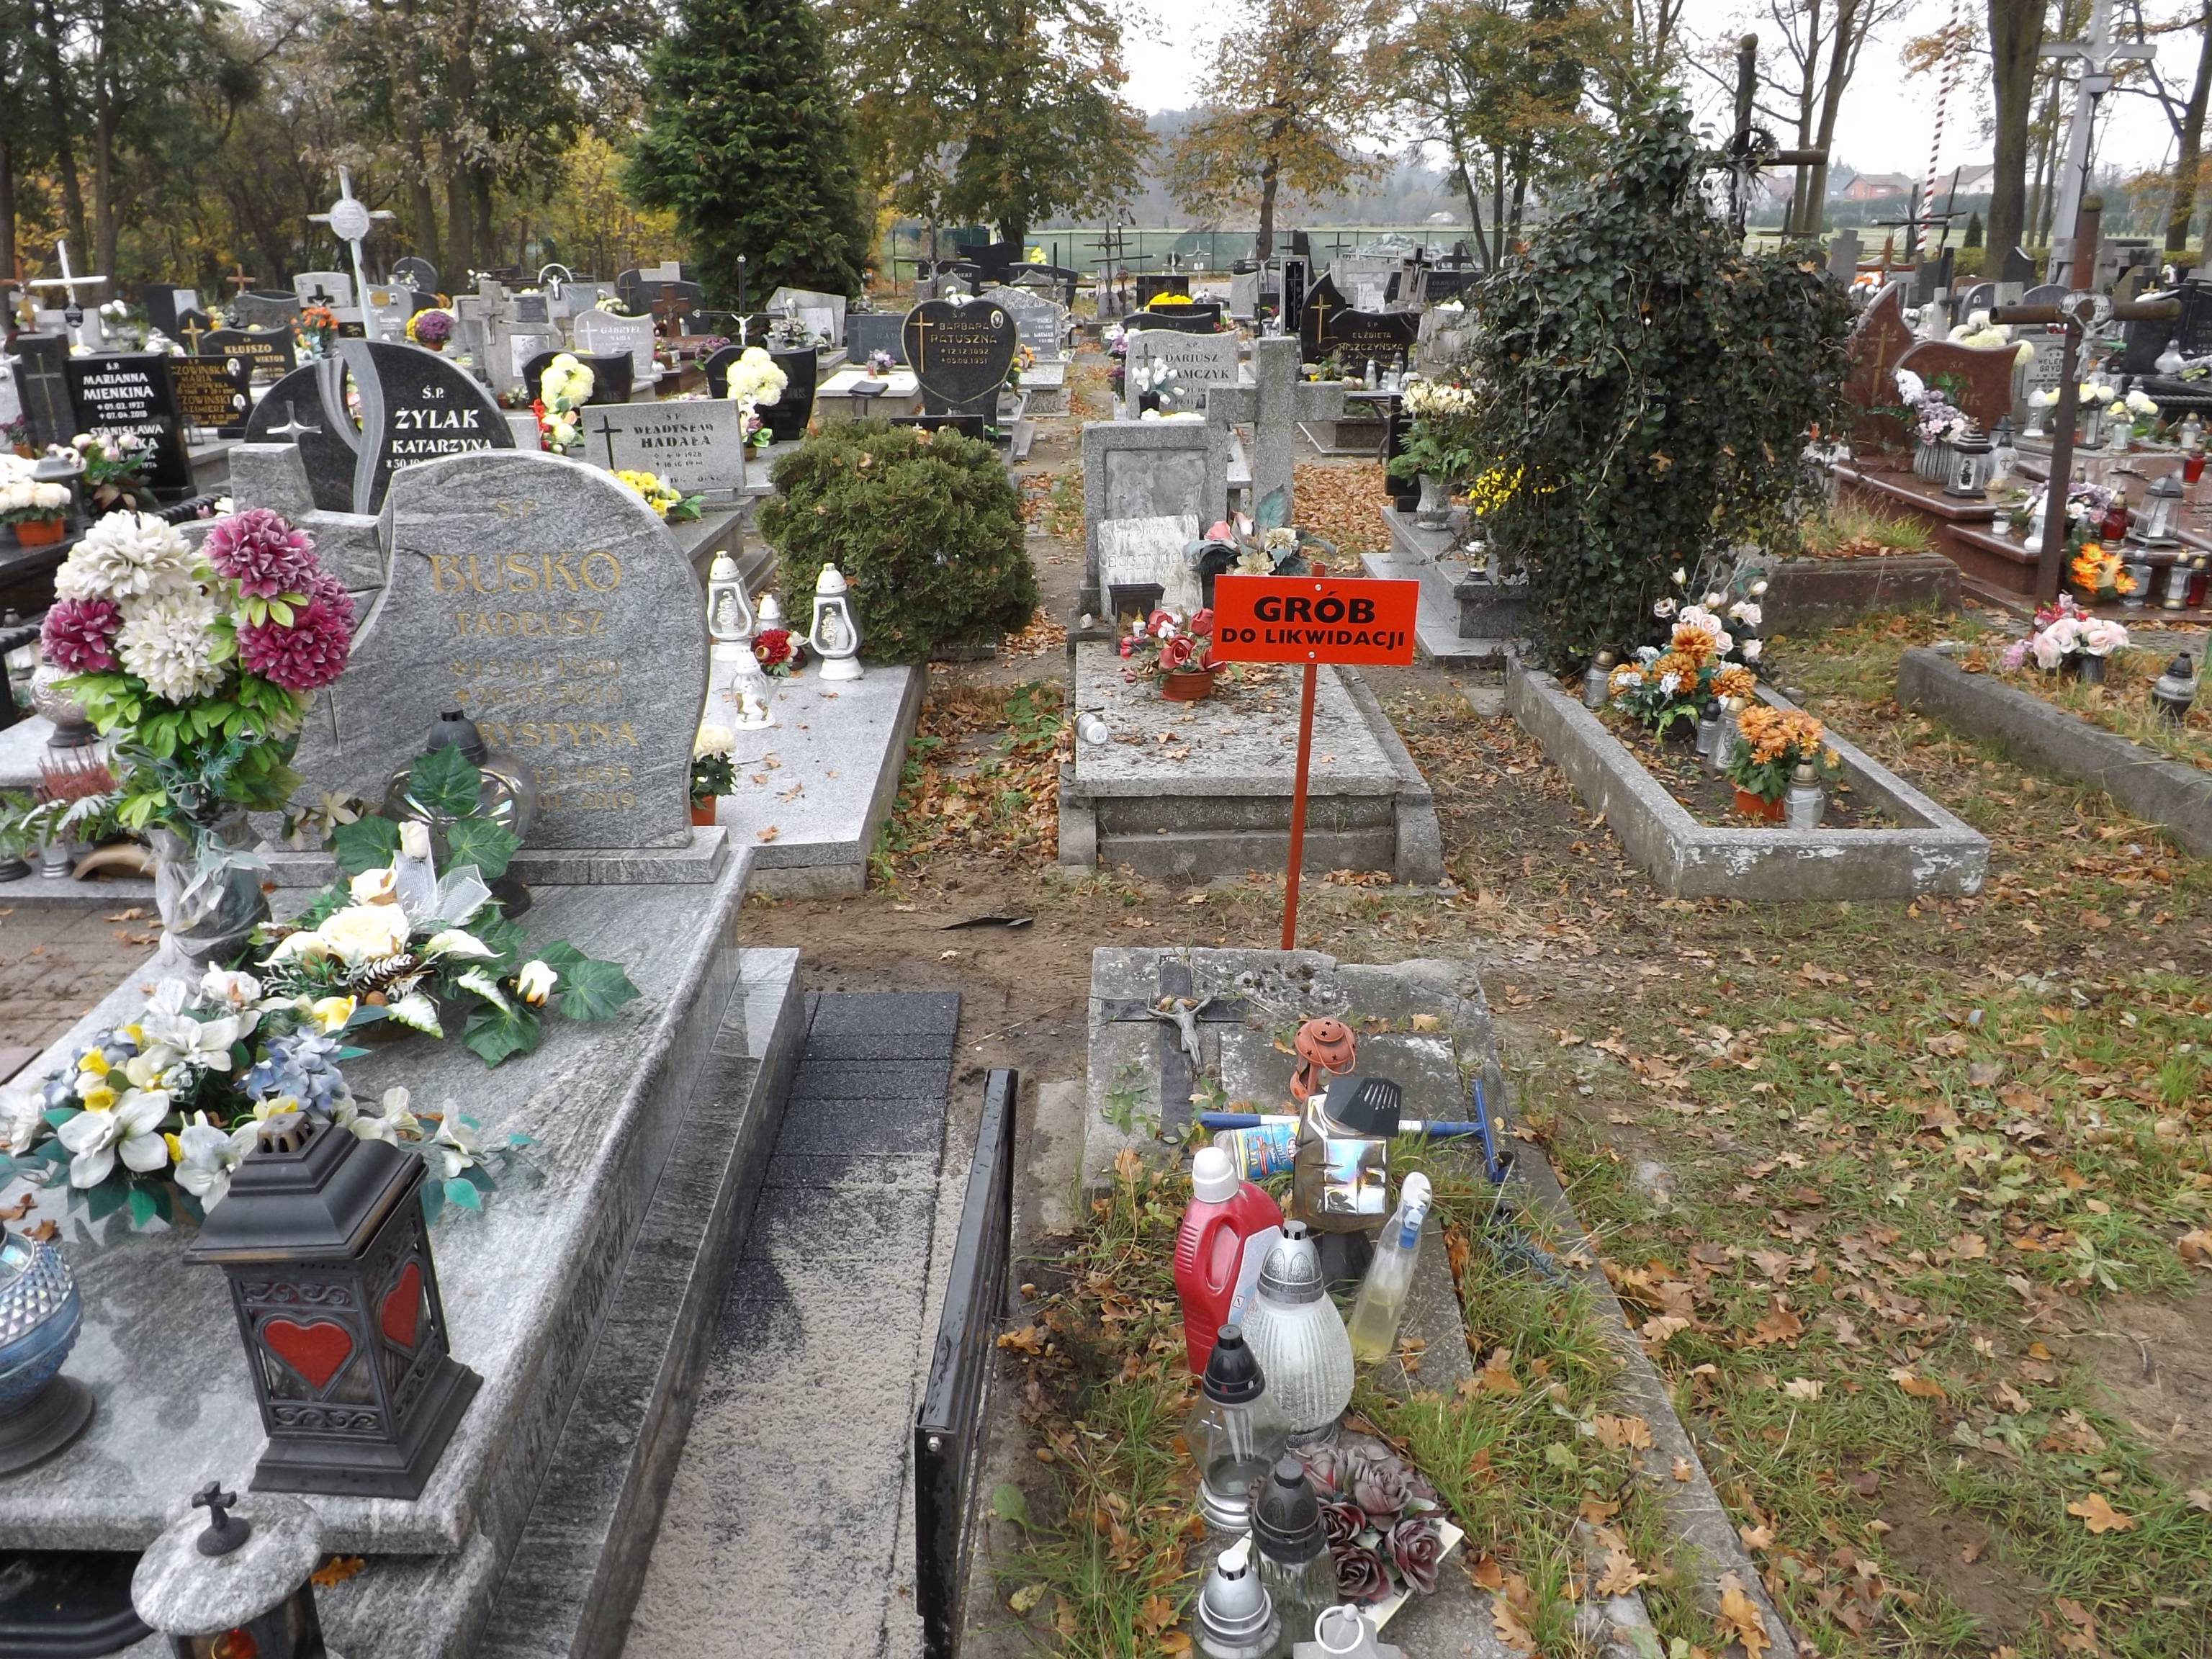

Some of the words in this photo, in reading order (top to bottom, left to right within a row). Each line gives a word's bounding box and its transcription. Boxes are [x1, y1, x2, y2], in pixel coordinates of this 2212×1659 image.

[1165, 354, 1219, 363] DARIUSZ
[84, 372, 148, 385] MARIANNA
[84, 385, 155, 401] MIENKINA
[394, 407, 480, 430] ŻYLAK
[392, 439, 493, 454] KATARZYNA
[429, 550, 622, 593] BUSKO
[1253, 590, 1376, 624] GRÓB
[452, 609, 608, 637] TADEUSZ
[1220, 628, 1256, 643] DO
[1264, 629, 1405, 651] LIKWIDACJI
[477, 722, 639, 746] RYSTYNA
